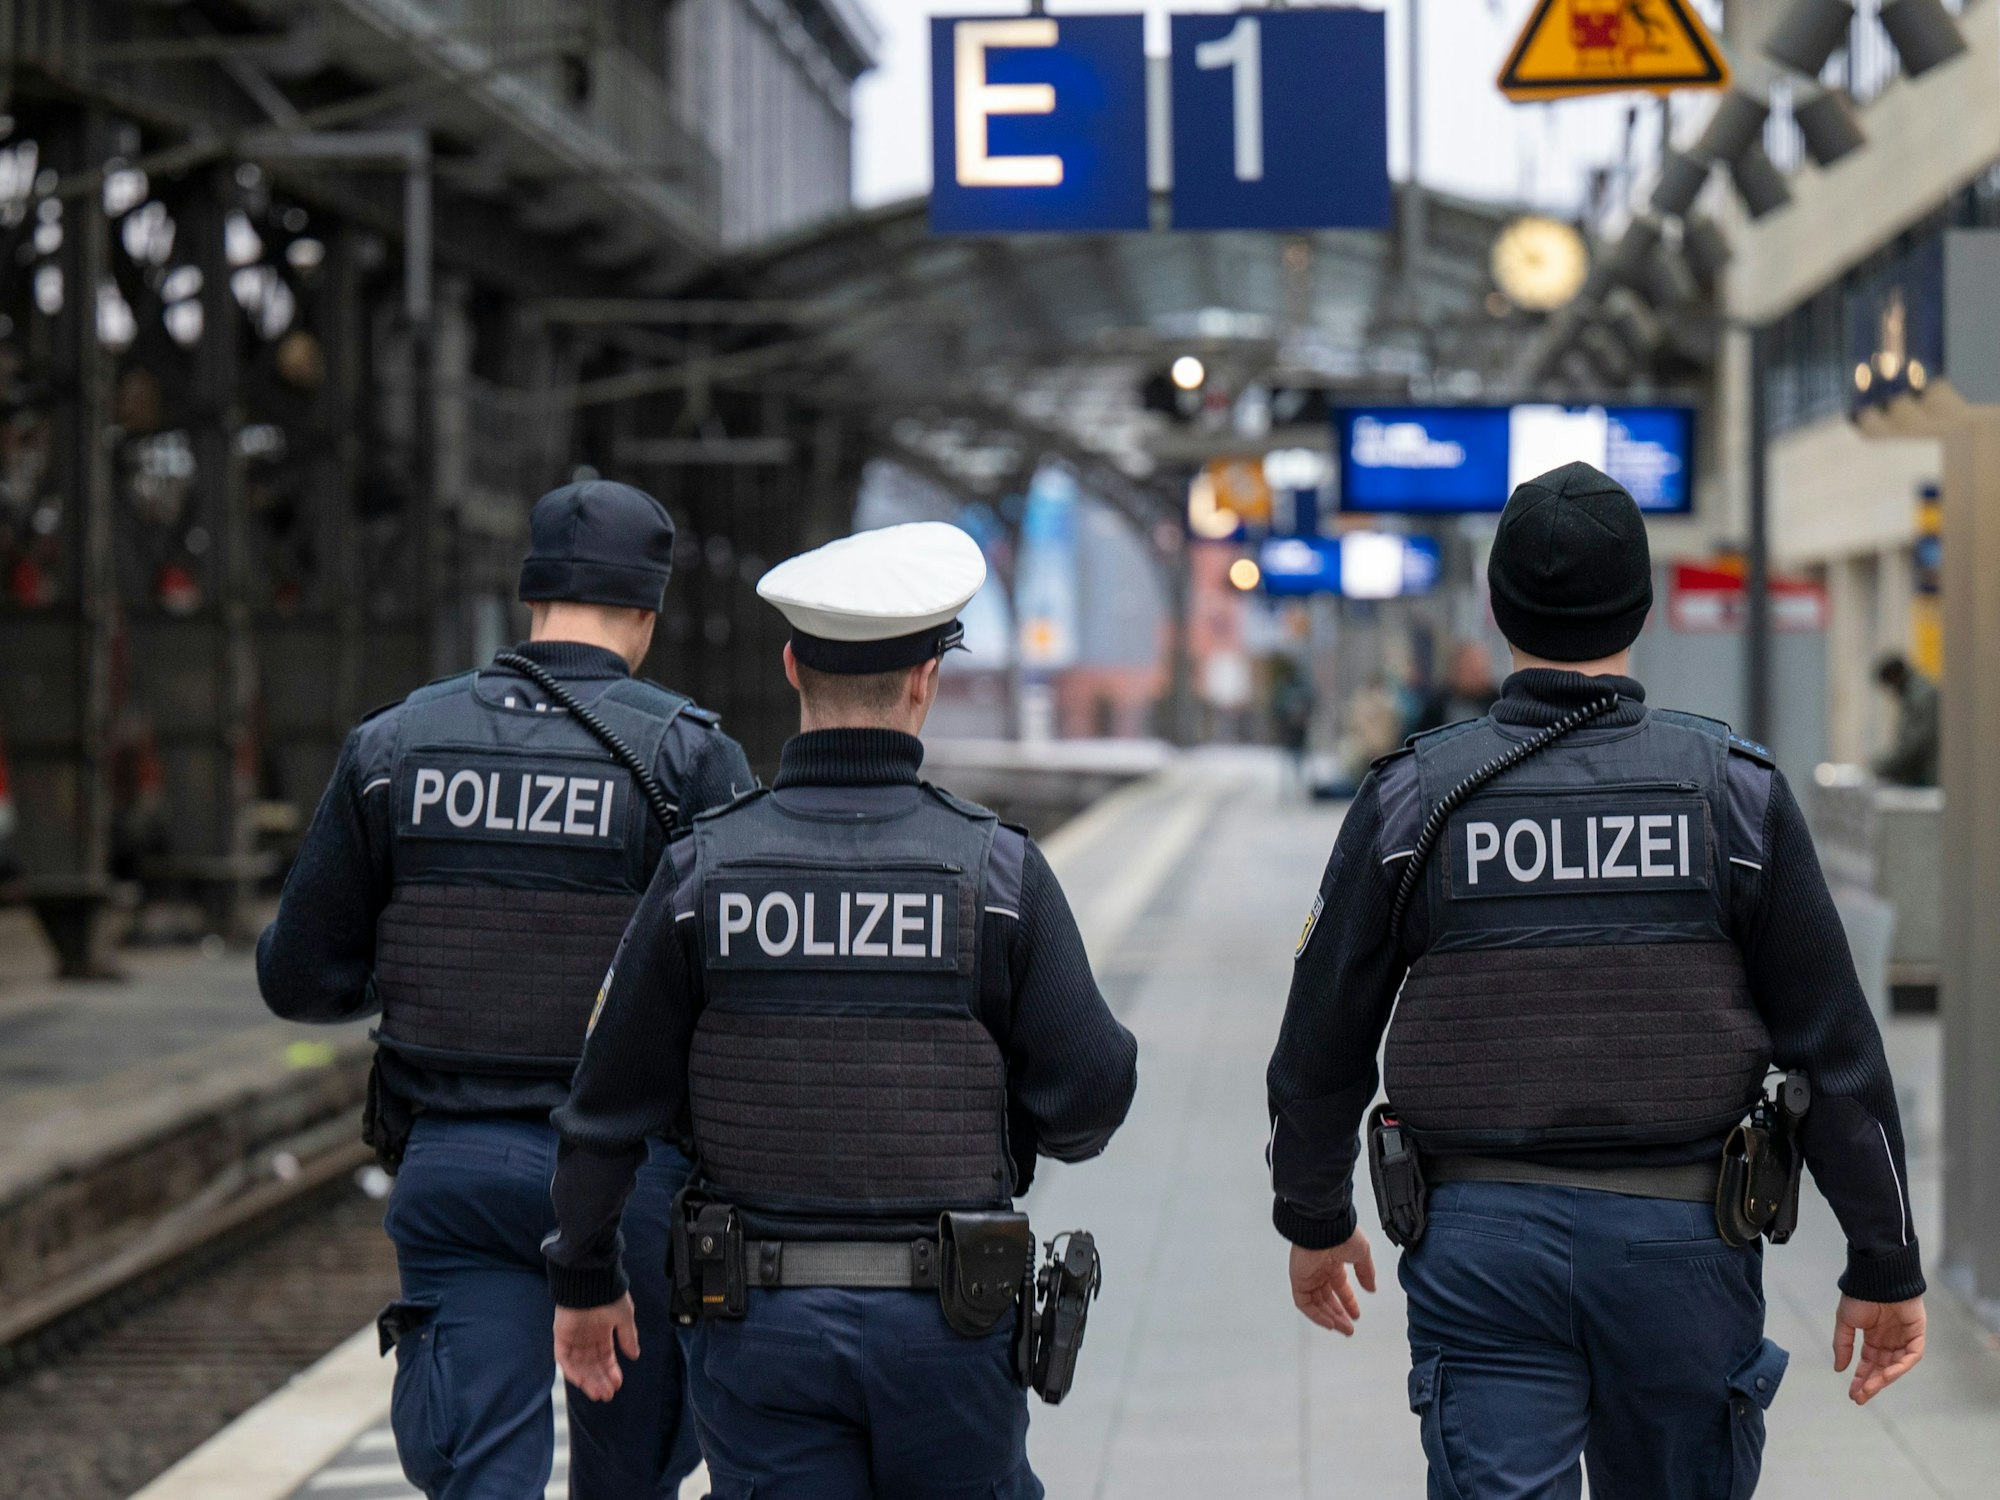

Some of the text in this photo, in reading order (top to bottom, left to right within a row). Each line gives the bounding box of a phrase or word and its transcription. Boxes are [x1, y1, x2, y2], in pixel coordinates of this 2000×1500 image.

[954, 18, 1064, 187] E
[1195, 17, 1264, 182] 1
[412, 768, 615, 837] POLIZEI
[1466, 814, 1690, 885] POLIZEI
[719, 892, 943, 957] POLIZEI
